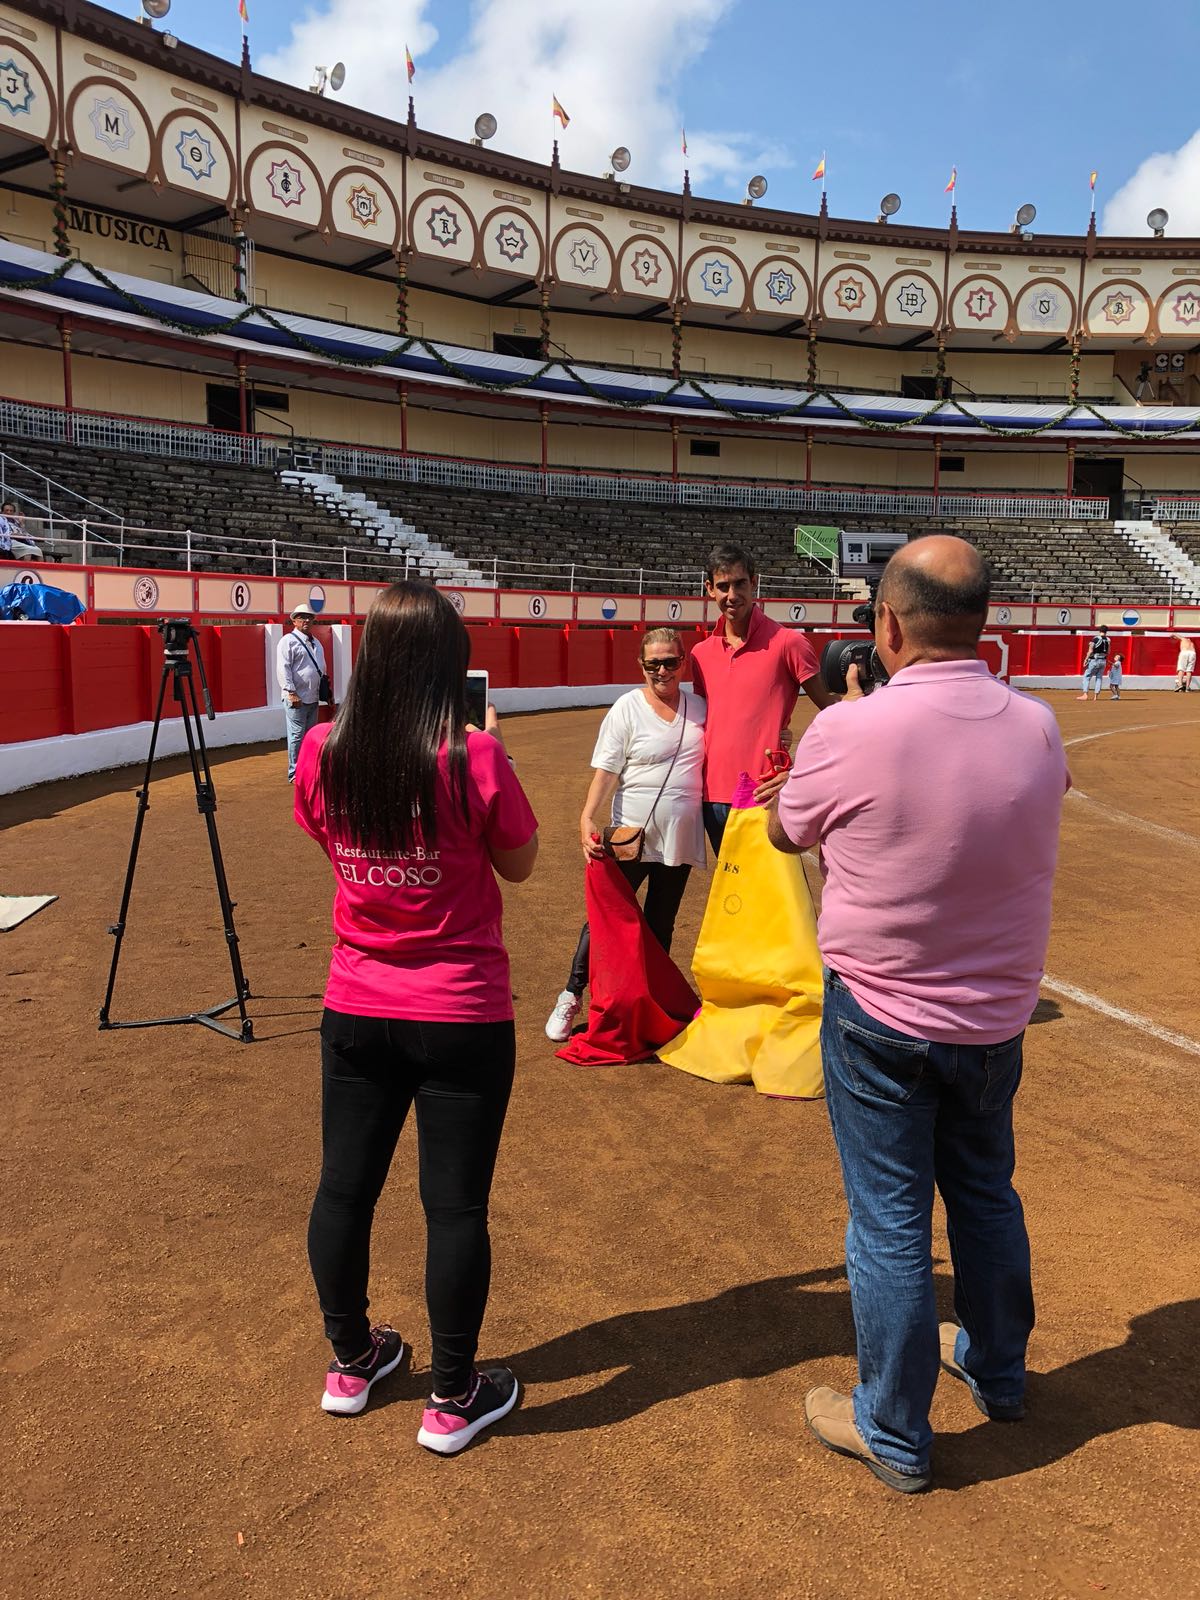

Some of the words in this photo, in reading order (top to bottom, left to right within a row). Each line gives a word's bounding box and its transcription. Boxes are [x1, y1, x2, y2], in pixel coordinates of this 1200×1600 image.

[104, 113, 120, 136] M
[68, 206, 172, 252] MUSICA
[579, 248, 590, 262] V
[712, 271, 722, 285] G
[777, 280, 785, 293] F
[1183, 303, 1195, 315] M
[235, 585, 244, 608] 6
[532, 598, 541, 616] 6
[671, 603, 678, 618] 7
[793, 606, 802, 619] 7
[1060, 610, 1067, 623] 7
